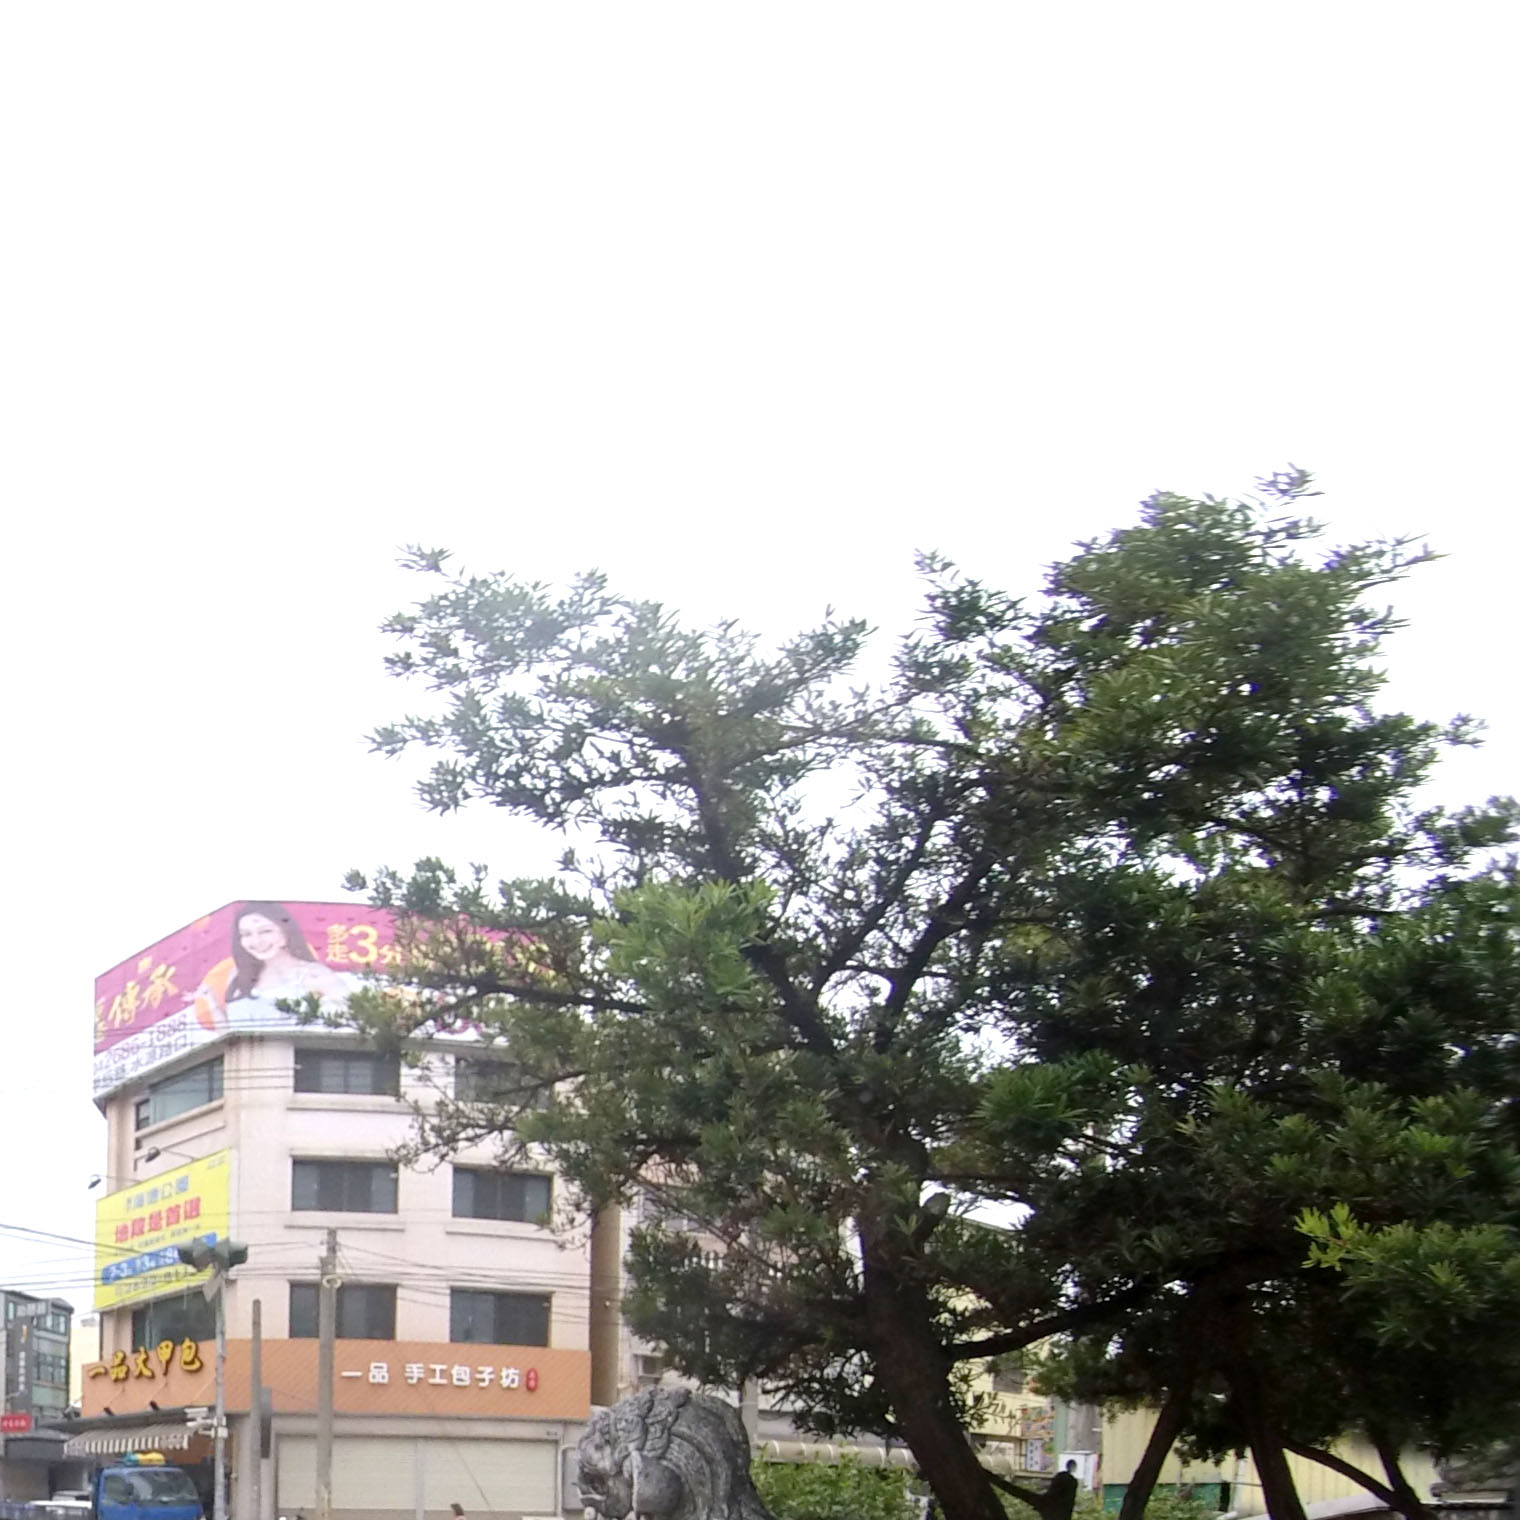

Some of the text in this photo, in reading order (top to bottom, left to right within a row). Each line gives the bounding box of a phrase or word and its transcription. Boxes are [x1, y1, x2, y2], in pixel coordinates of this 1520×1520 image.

[340, 1362, 390, 1385] 一品
[405, 1362, 521, 1389] 手工包子坊
